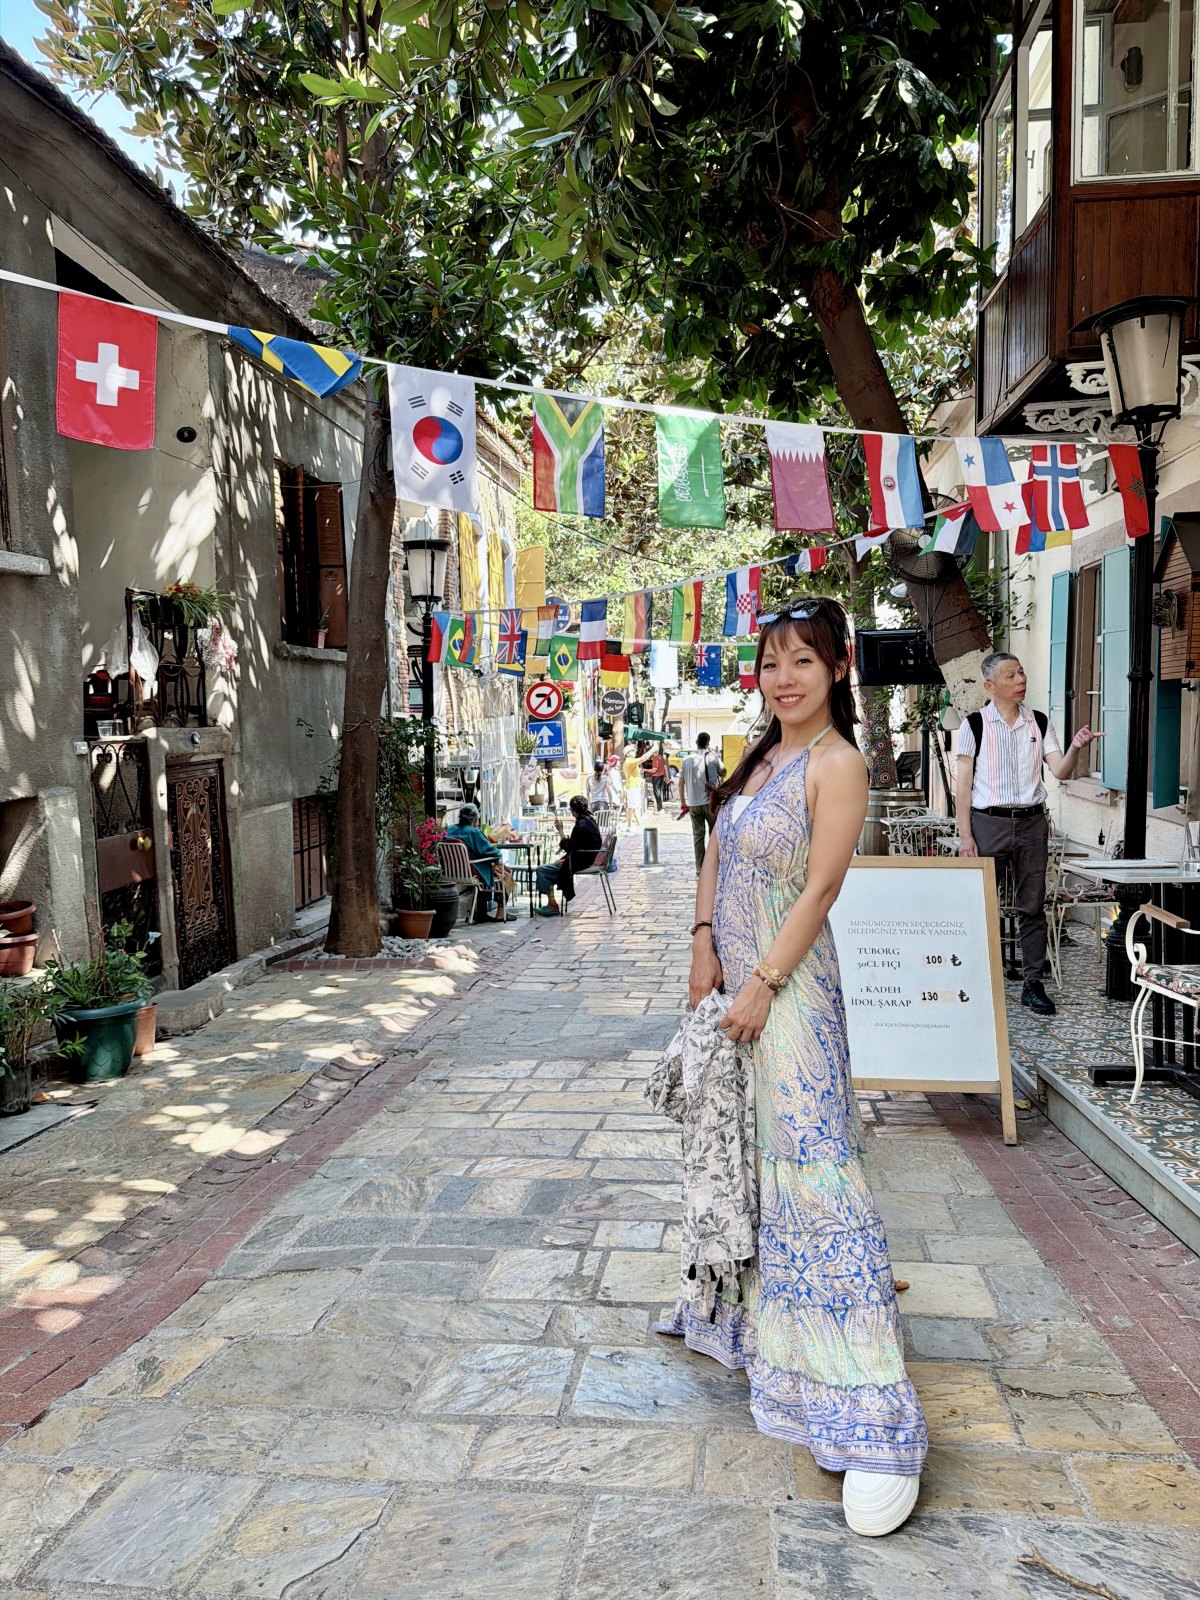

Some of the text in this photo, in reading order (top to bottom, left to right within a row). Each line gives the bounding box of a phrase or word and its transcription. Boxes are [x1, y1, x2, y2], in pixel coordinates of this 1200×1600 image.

[850, 919, 964, 930] MENÜMÜZDEN SEÇECEĞİNİZ
[847, 927, 897, 935] DİLEDİĞİNİZ
[899, 928, 928, 936] YEMEK
[856, 947, 900, 955] TUBORG
[926, 955, 942, 964] 100
[856, 960, 901, 970] 50CL FIÇI
[866, 985, 901, 993] KADEH
[921, 991, 938, 1001] 130
[851, 996, 912, 1009] İDOL ŞARAP
